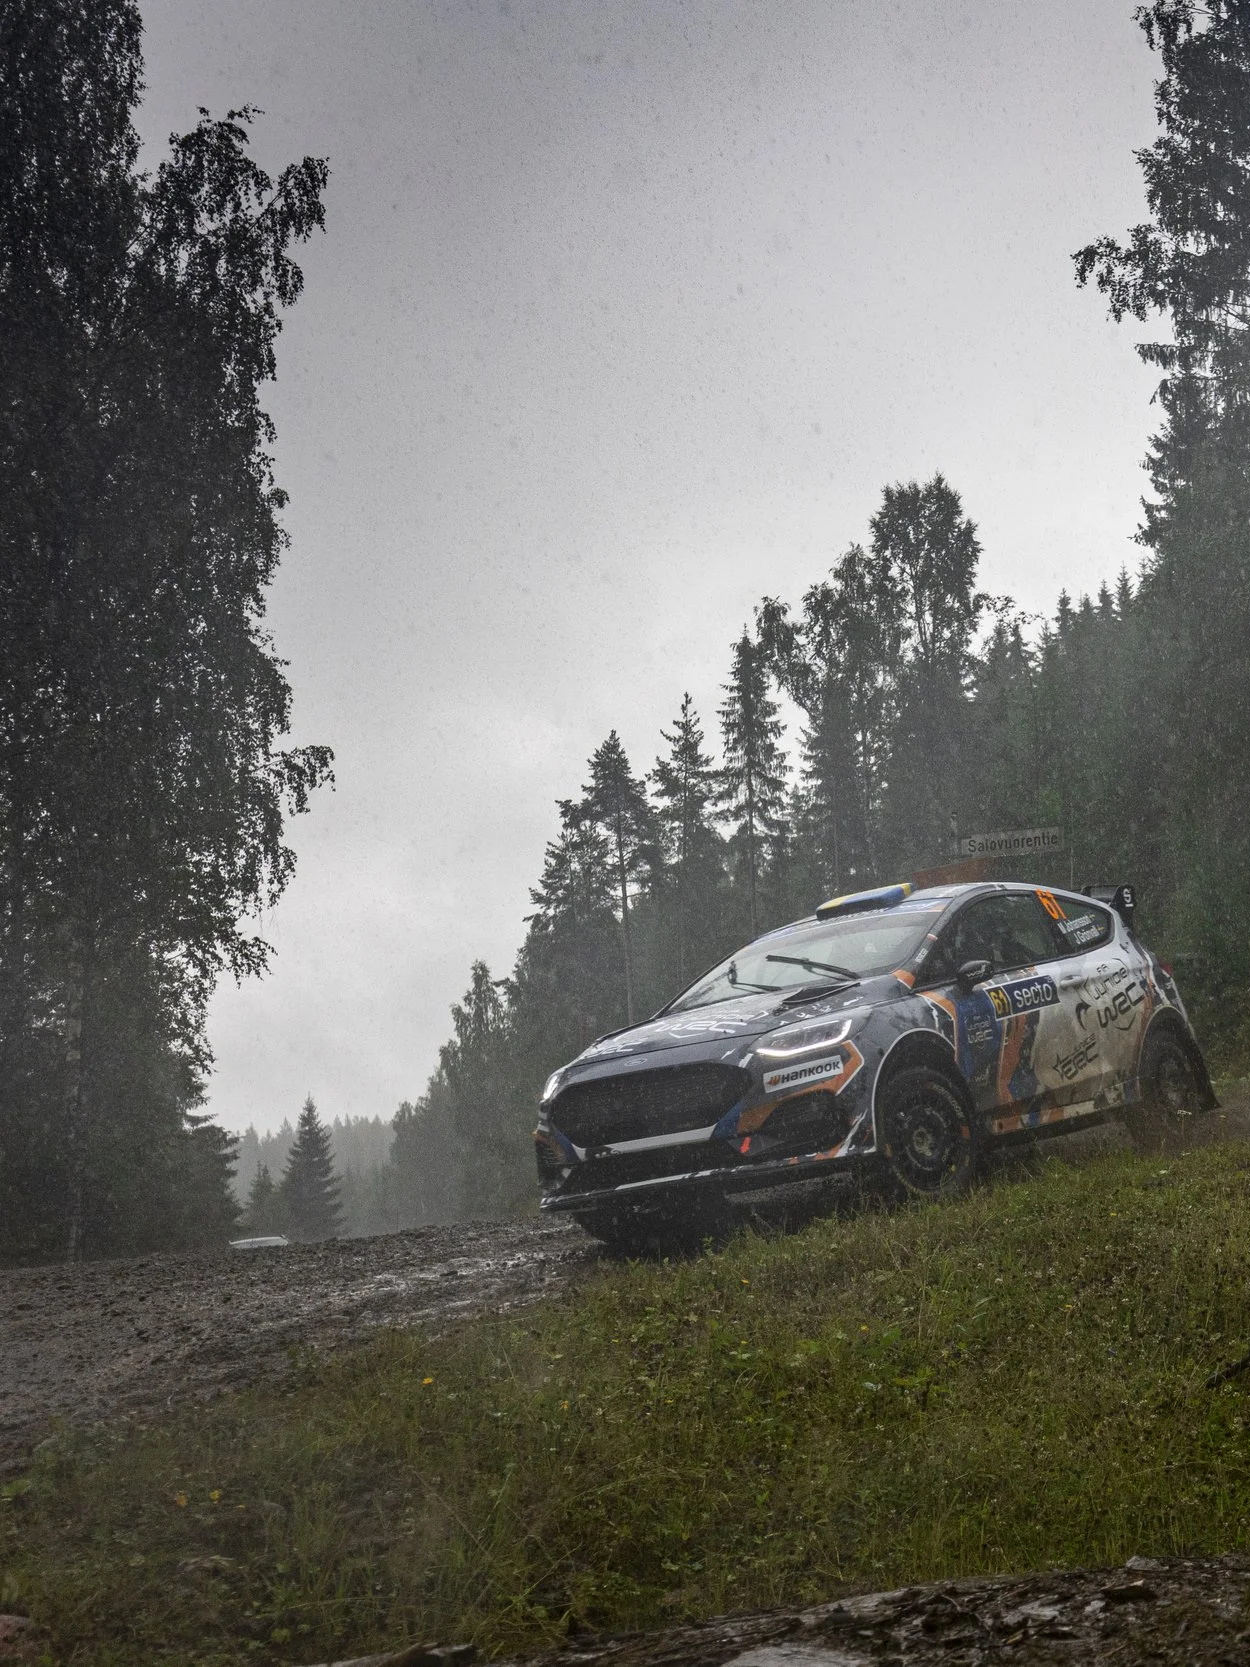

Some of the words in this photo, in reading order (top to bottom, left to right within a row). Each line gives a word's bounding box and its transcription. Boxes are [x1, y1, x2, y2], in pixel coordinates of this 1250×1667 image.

[1035, 888, 1067, 920] 61
[990, 989, 1009, 1015] 61
[1013, 982, 1052, 1008] secto
[1097, 982, 1145, 1028] WRC
